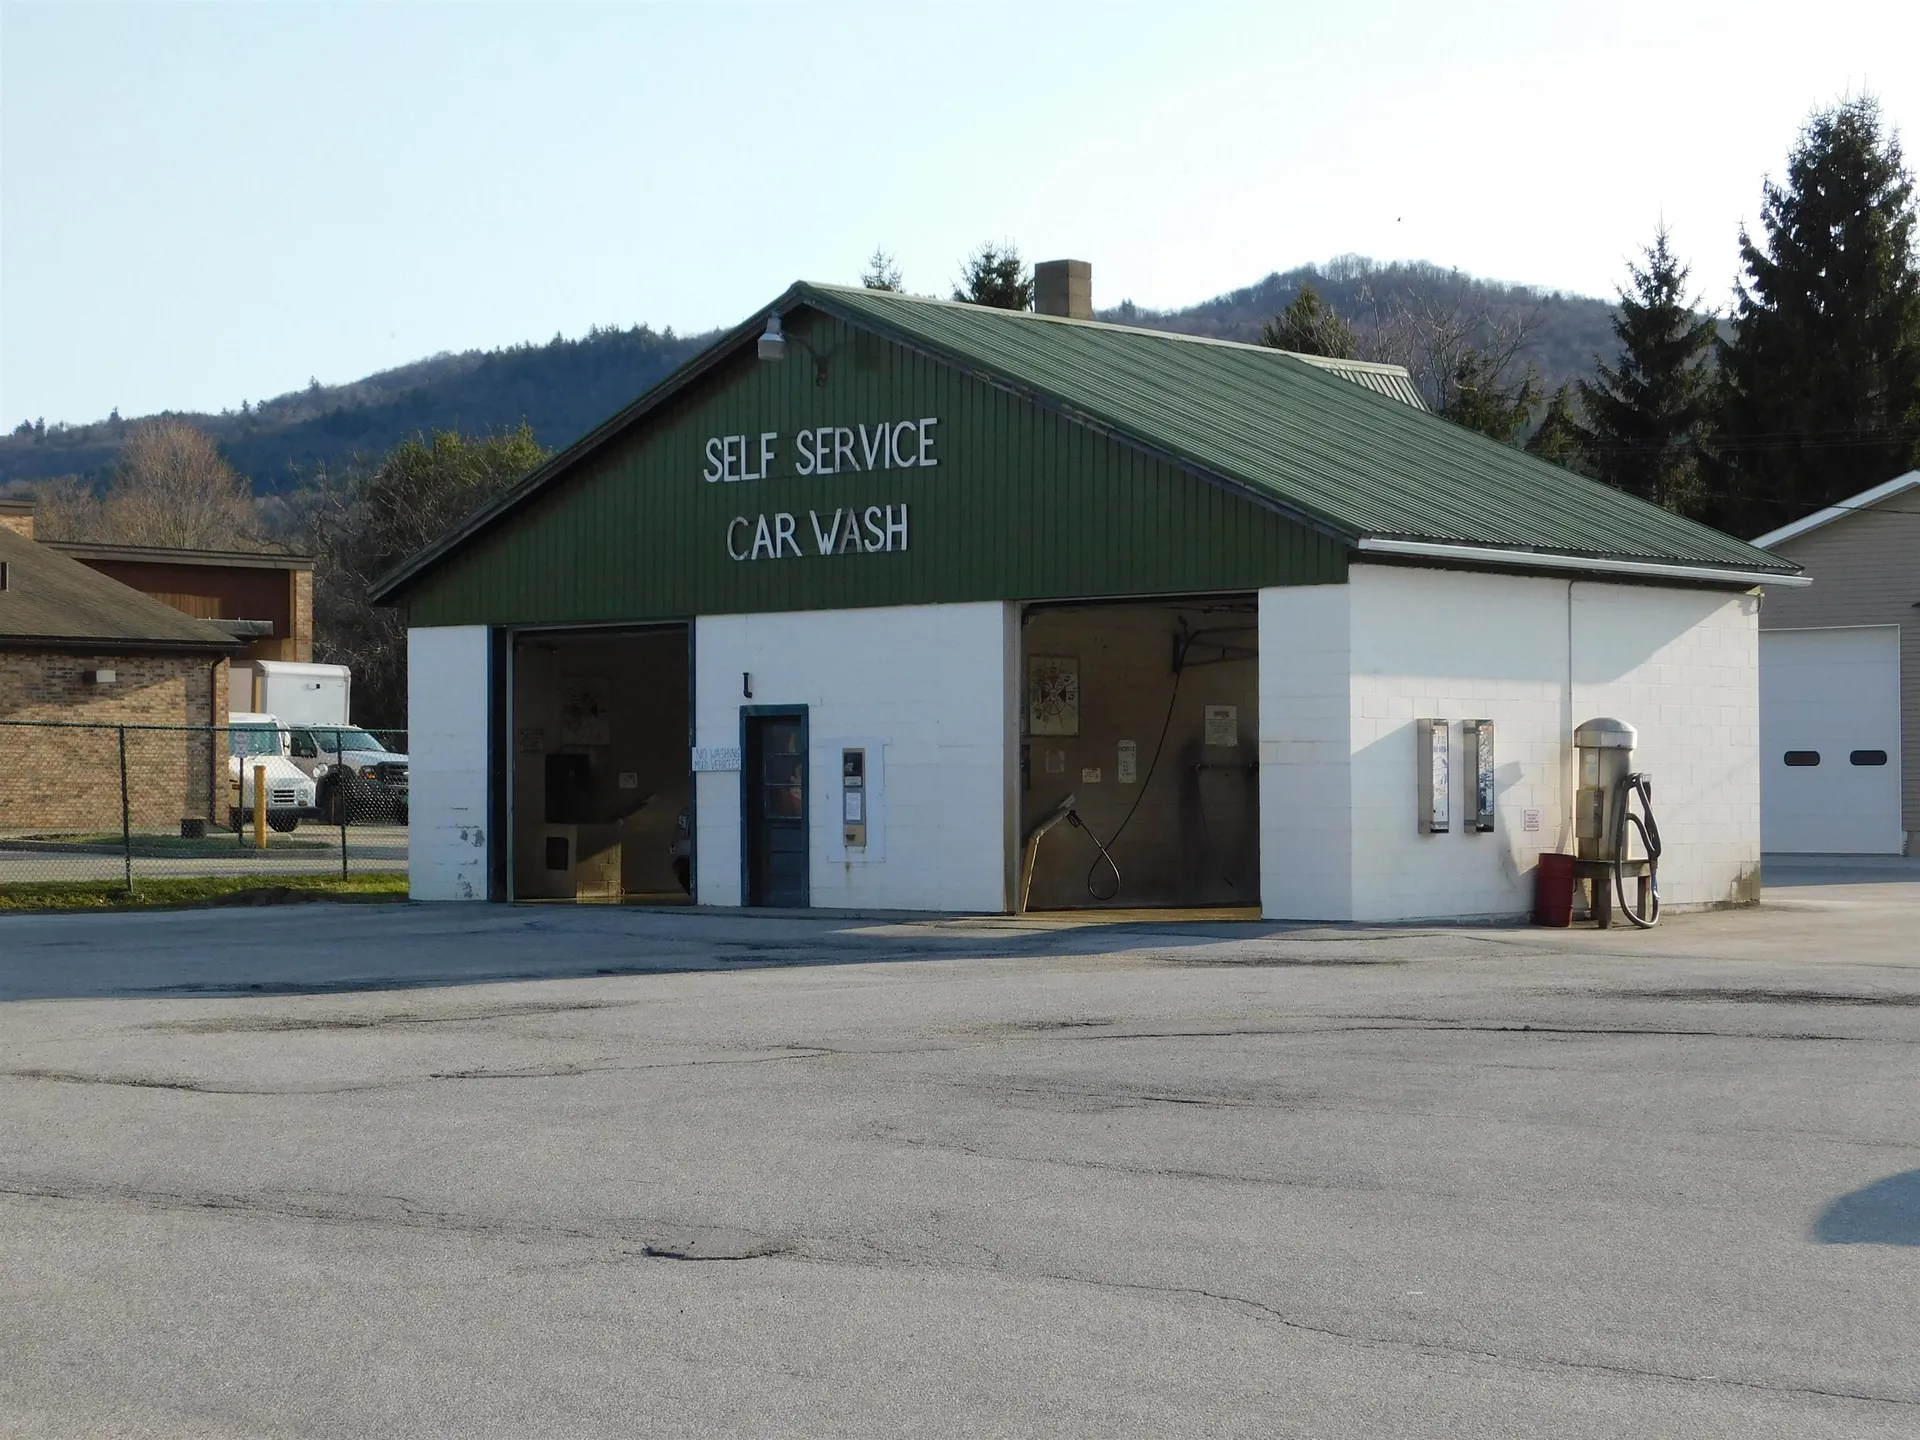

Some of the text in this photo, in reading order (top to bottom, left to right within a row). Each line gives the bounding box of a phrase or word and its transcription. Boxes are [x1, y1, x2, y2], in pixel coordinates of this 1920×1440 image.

[703, 417, 938, 483] SELF SERVICE
[727, 503, 908, 561] CAR WASH
[696, 747, 741, 760] NO WASHING
[710, 758, 741, 770] VEHICLES
